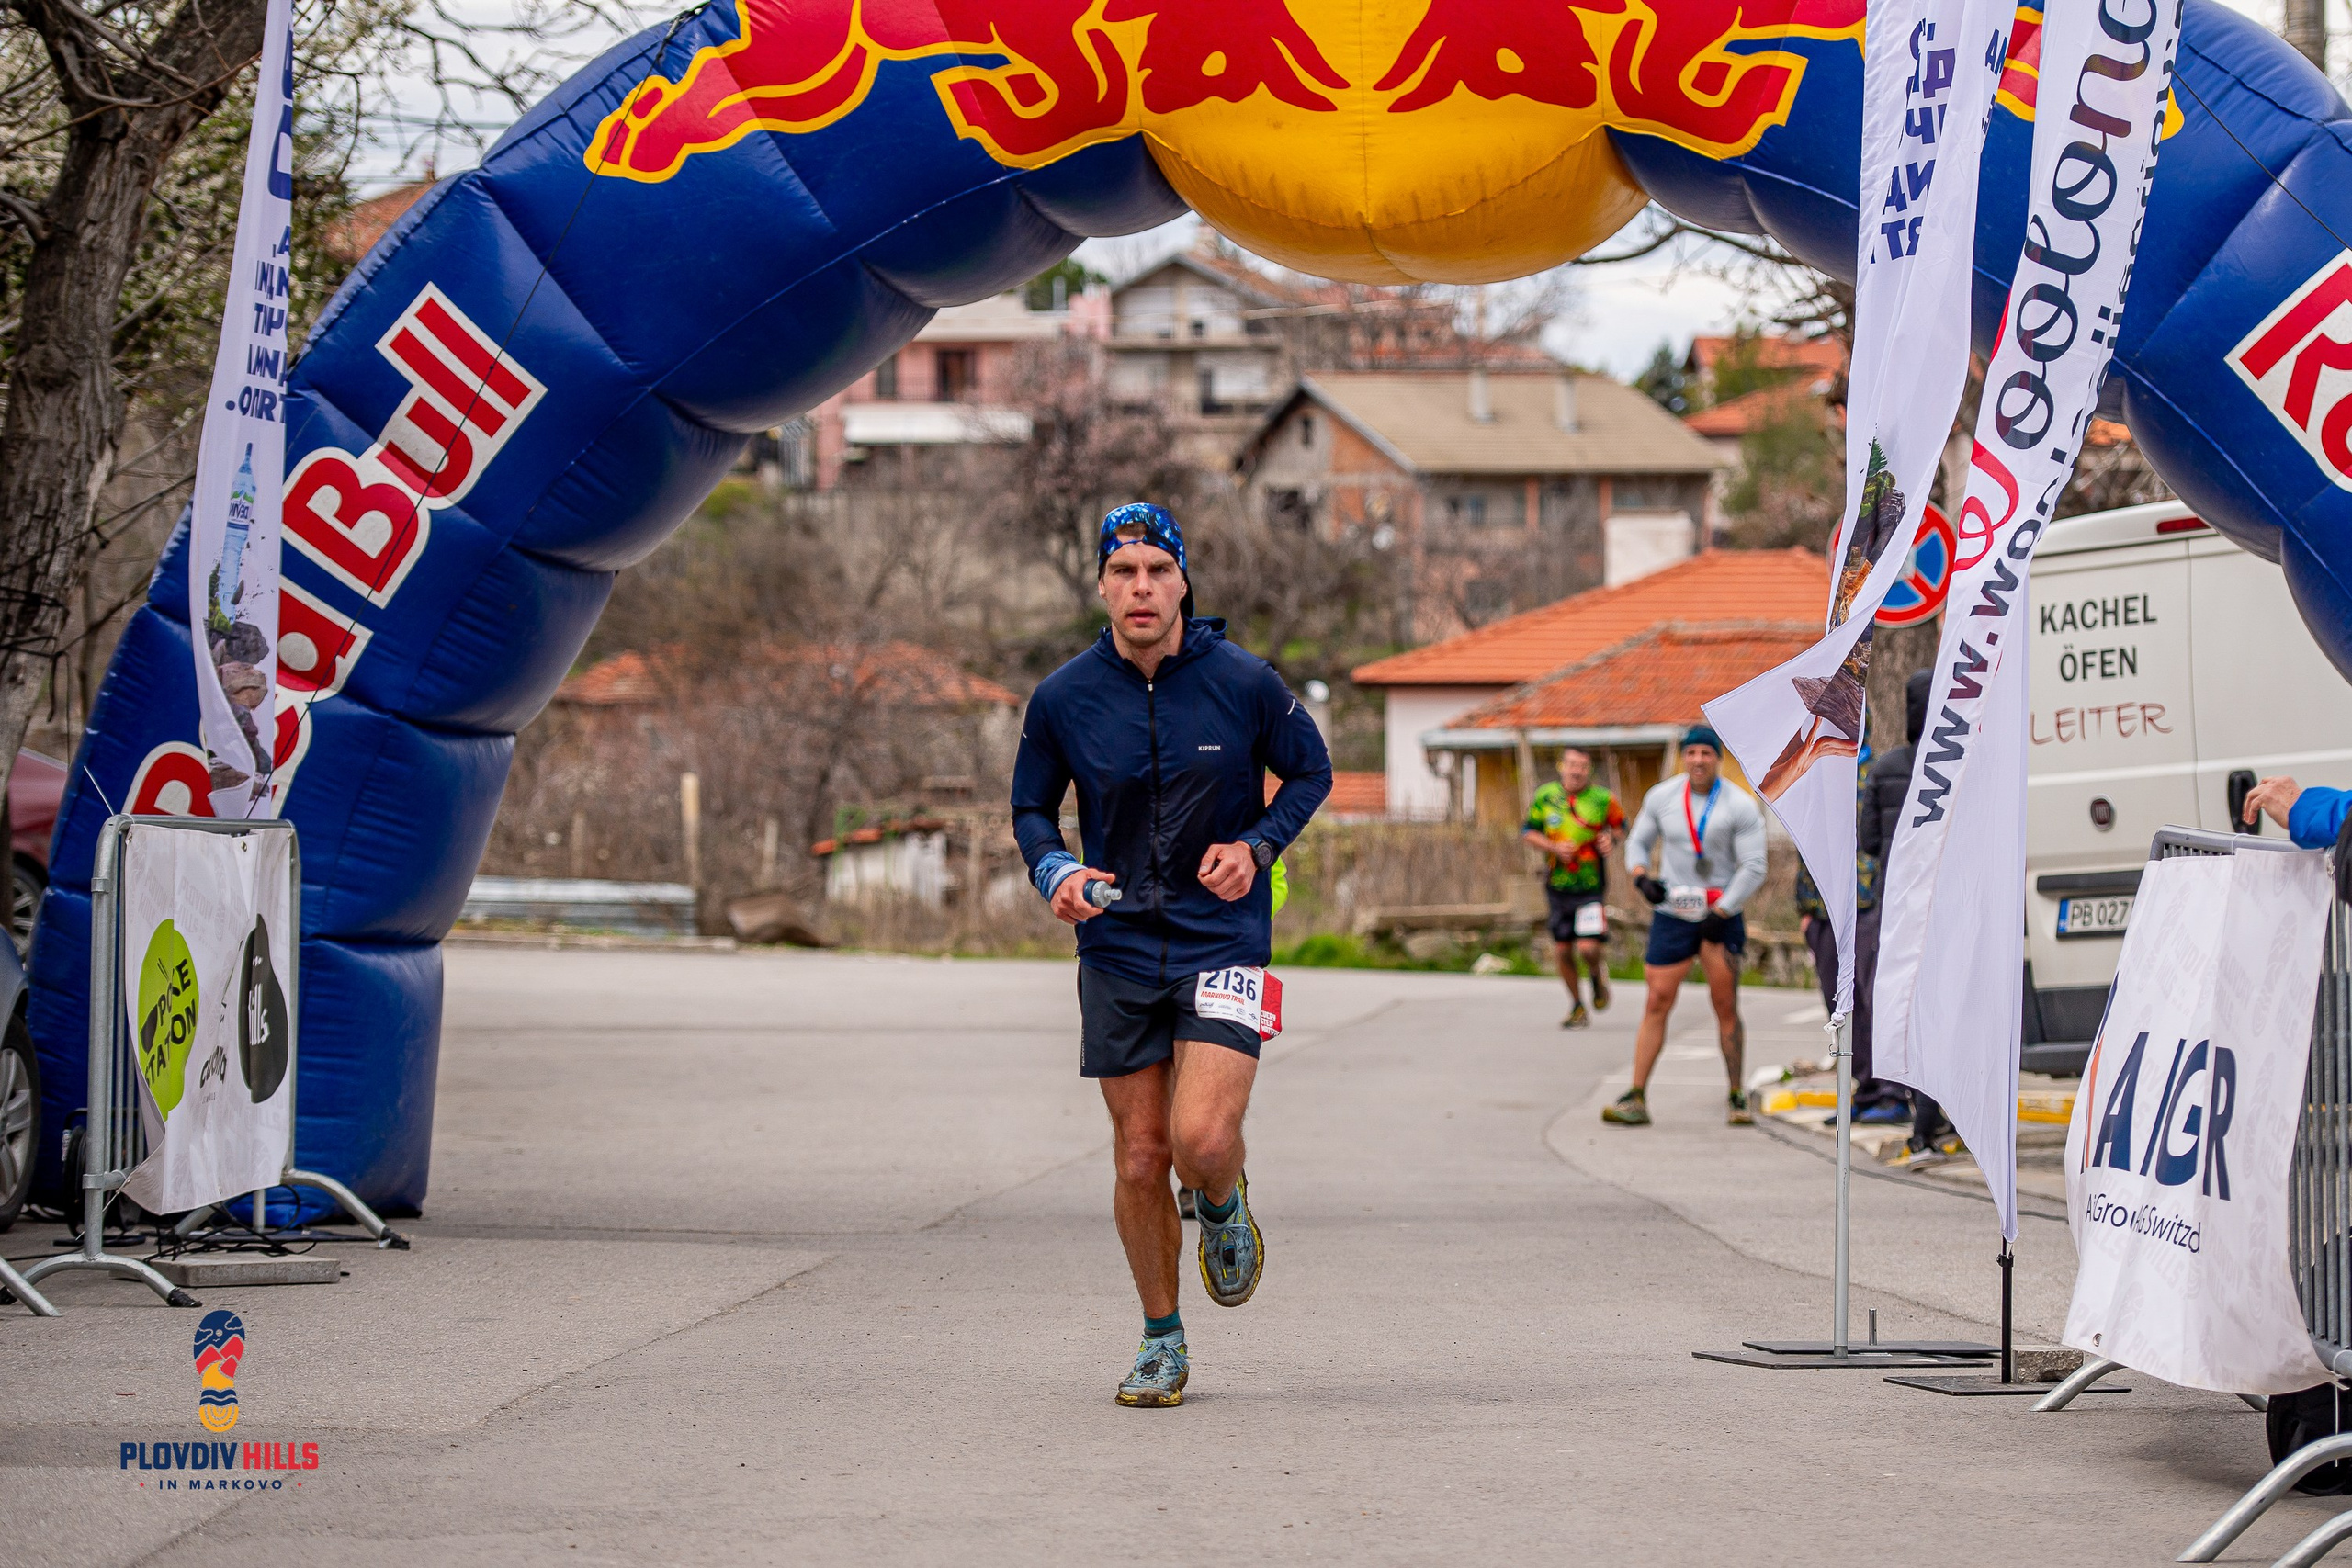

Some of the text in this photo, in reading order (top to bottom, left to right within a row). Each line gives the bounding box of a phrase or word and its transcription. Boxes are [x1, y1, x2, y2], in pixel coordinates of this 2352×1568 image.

[281, 296, 532, 594] Bull
[2041, 592, 2157, 636] KACHEL
[2059, 643, 2138, 682] ÖFEN
[2030, 701, 2174, 745] LEITER
[2070, 900, 2134, 927] PB 027
[1200, 990, 1245, 1006] MARKOVO TRAIL
[1204, 969, 1257, 1002] 2136
